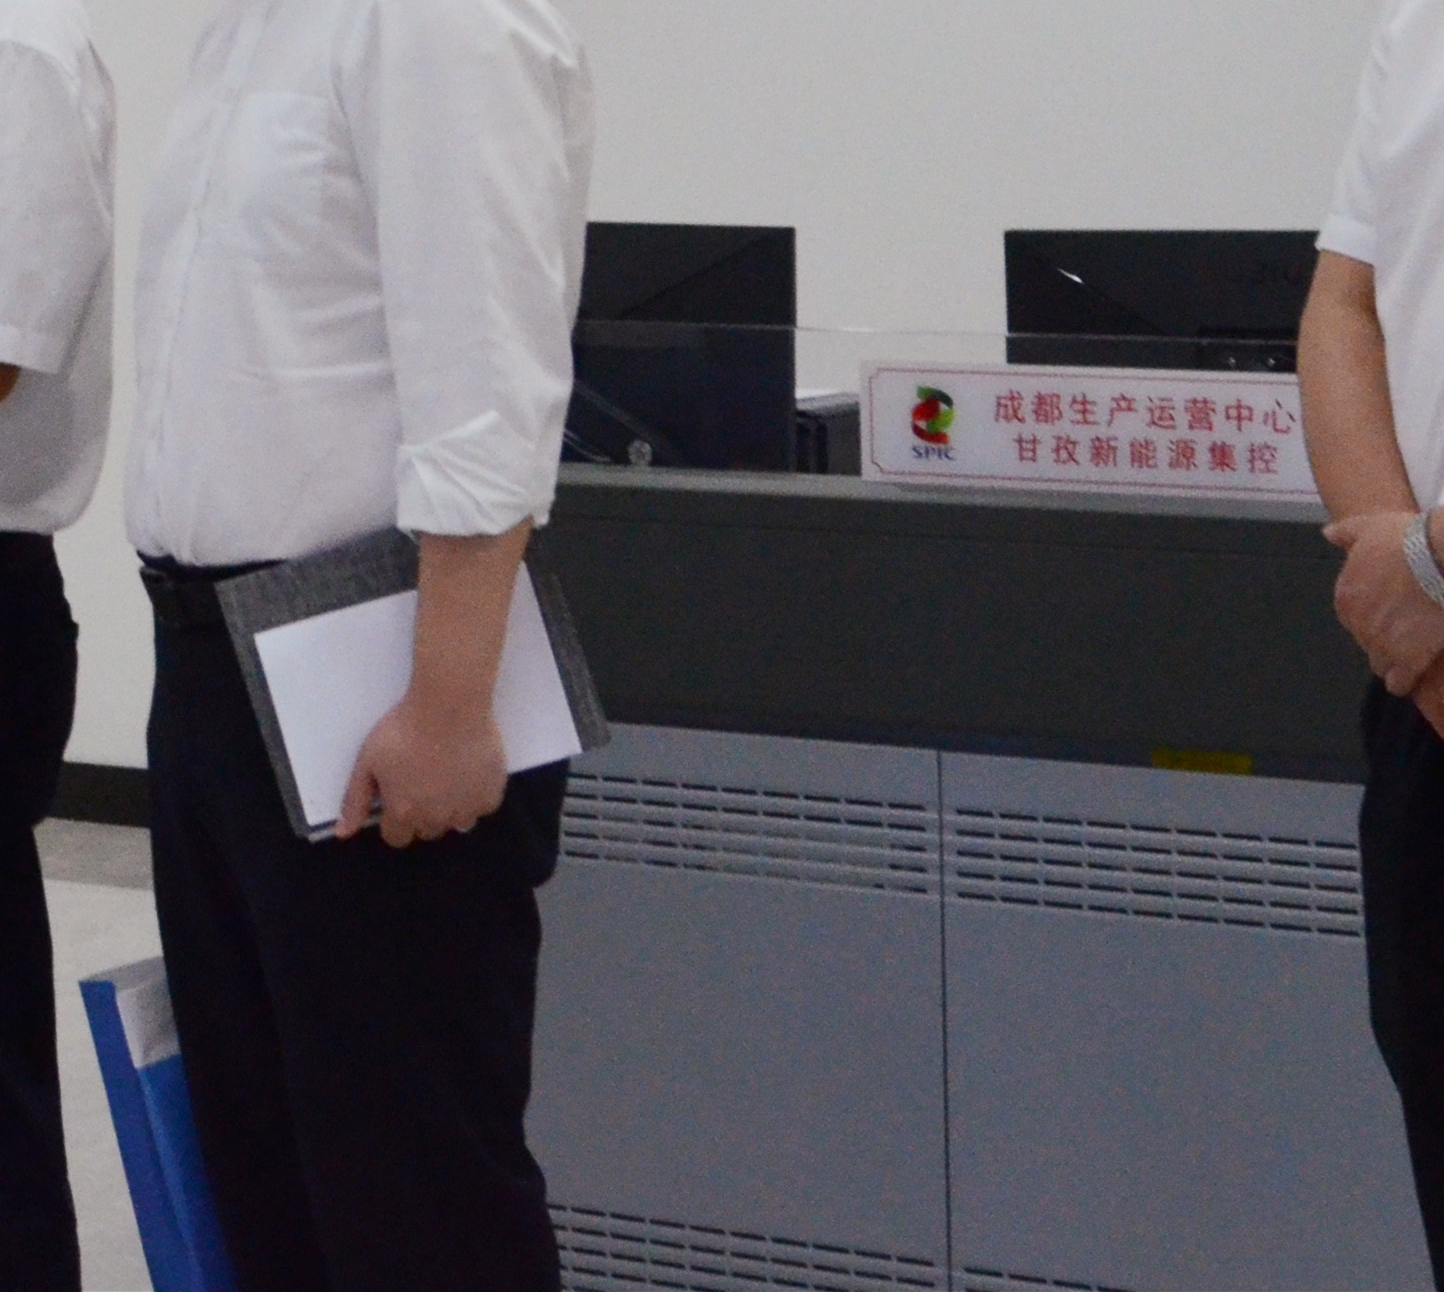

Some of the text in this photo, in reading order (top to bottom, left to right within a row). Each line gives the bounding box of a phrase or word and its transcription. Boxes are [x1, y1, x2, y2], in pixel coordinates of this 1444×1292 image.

[994, 388, 1297, 435] 成都生产运营中心
[912, 445, 955, 462] SPIC
[1014, 432, 1278, 475] 甘孜新能源集控
